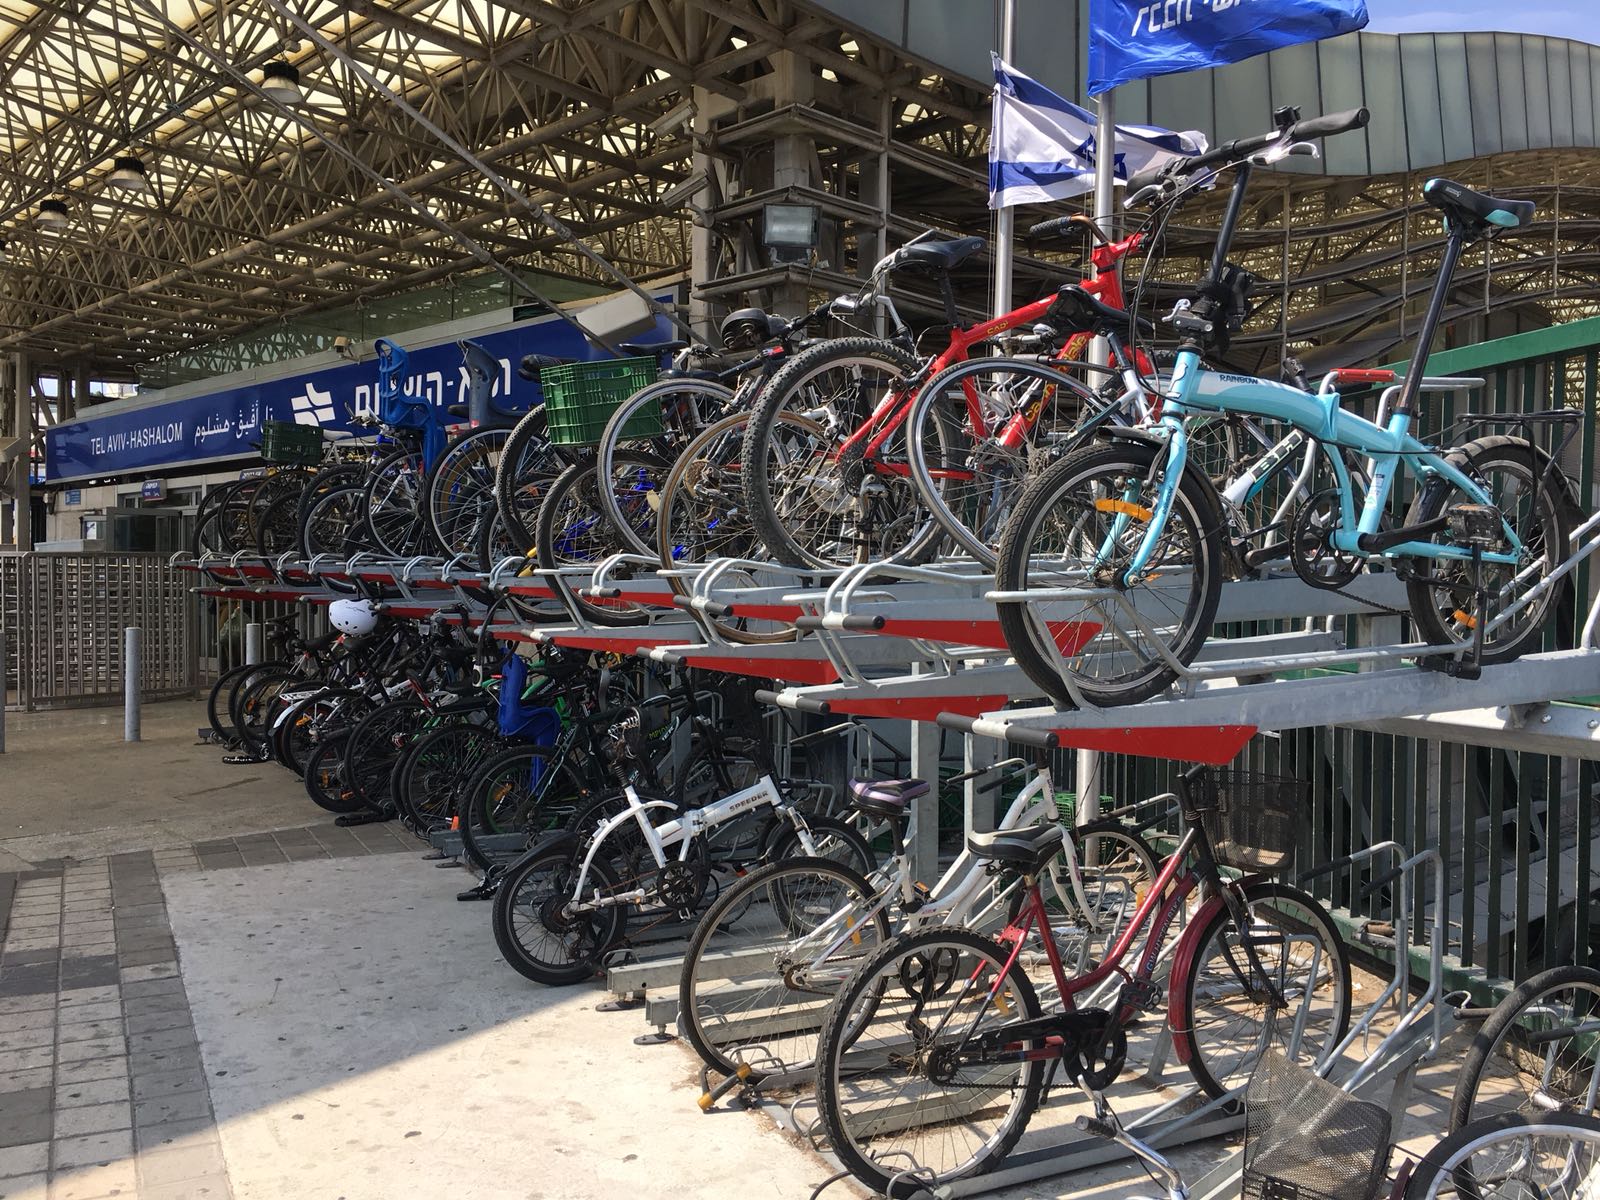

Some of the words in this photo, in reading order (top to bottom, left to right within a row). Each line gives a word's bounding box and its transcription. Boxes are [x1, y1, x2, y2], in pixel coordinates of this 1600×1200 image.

[1219, 374, 1258, 385] RAINBOW
[90, 437, 106, 455] TEL
[106, 421, 183, 453] AVIV-HASHALOM
[728, 790, 769, 812] SPEEDER
